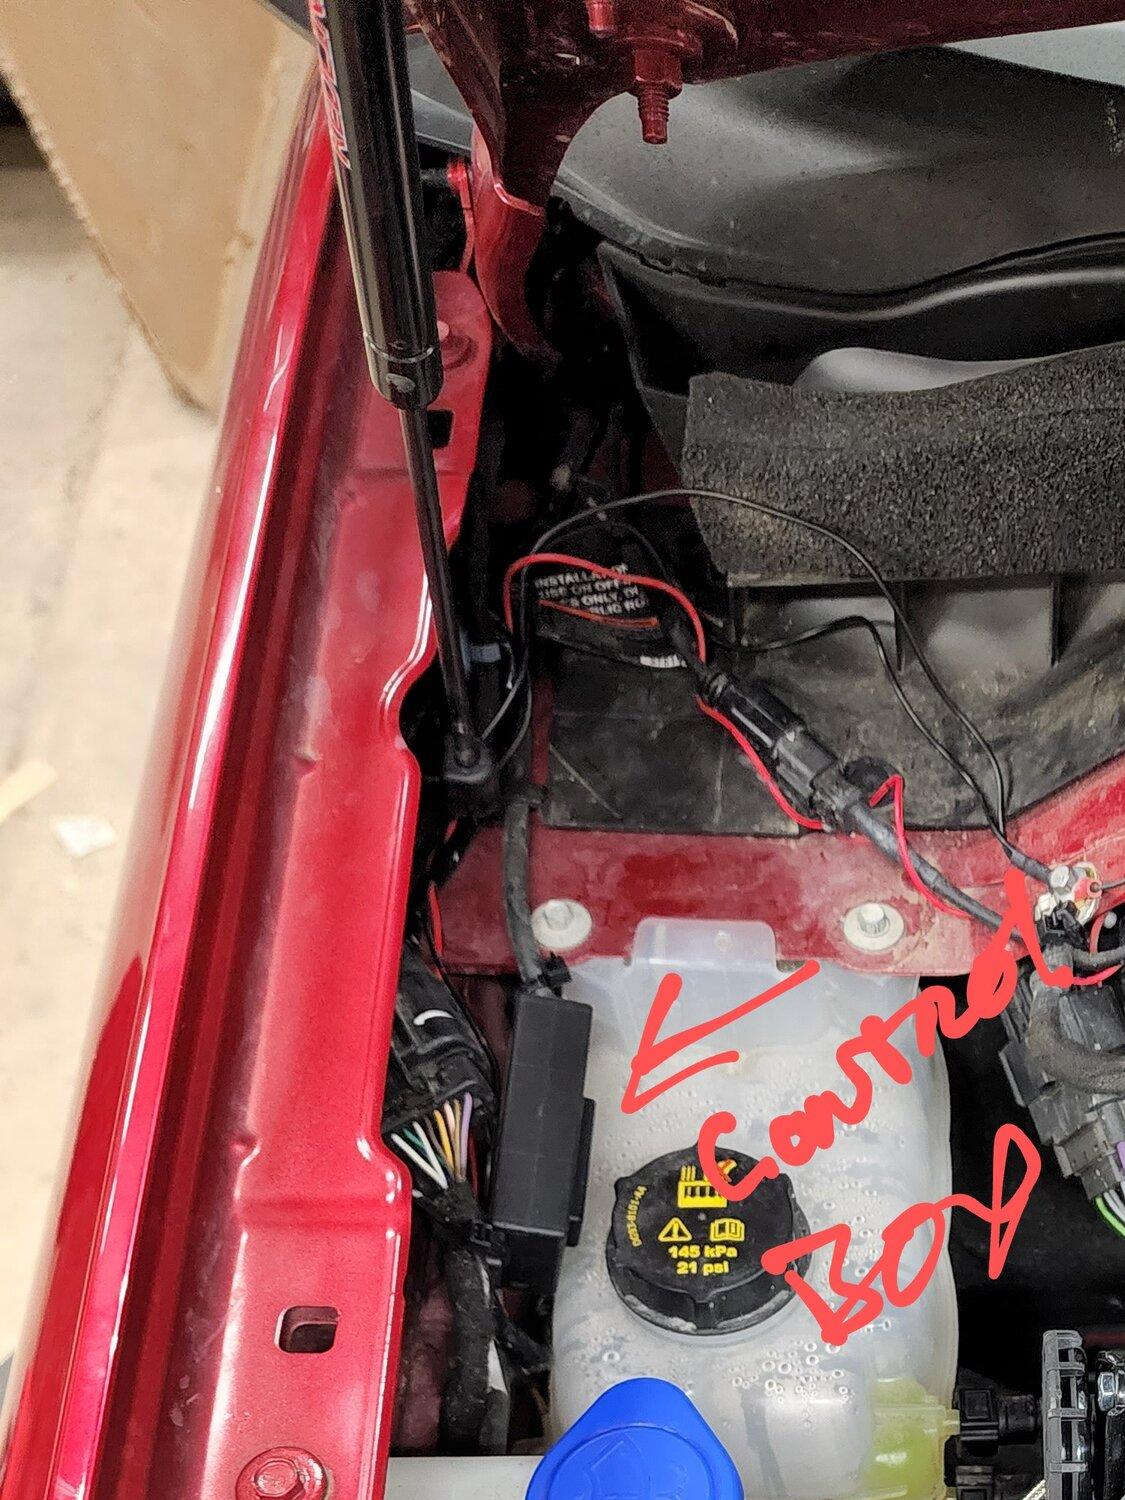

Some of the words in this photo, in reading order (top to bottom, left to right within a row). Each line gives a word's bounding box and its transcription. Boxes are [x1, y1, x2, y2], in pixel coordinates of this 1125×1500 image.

[668, 1244, 701, 1258] 145
[703, 1244, 738, 1258] kPa
[676, 1260, 698, 1275] 21
[702, 1260, 730, 1276] psi
